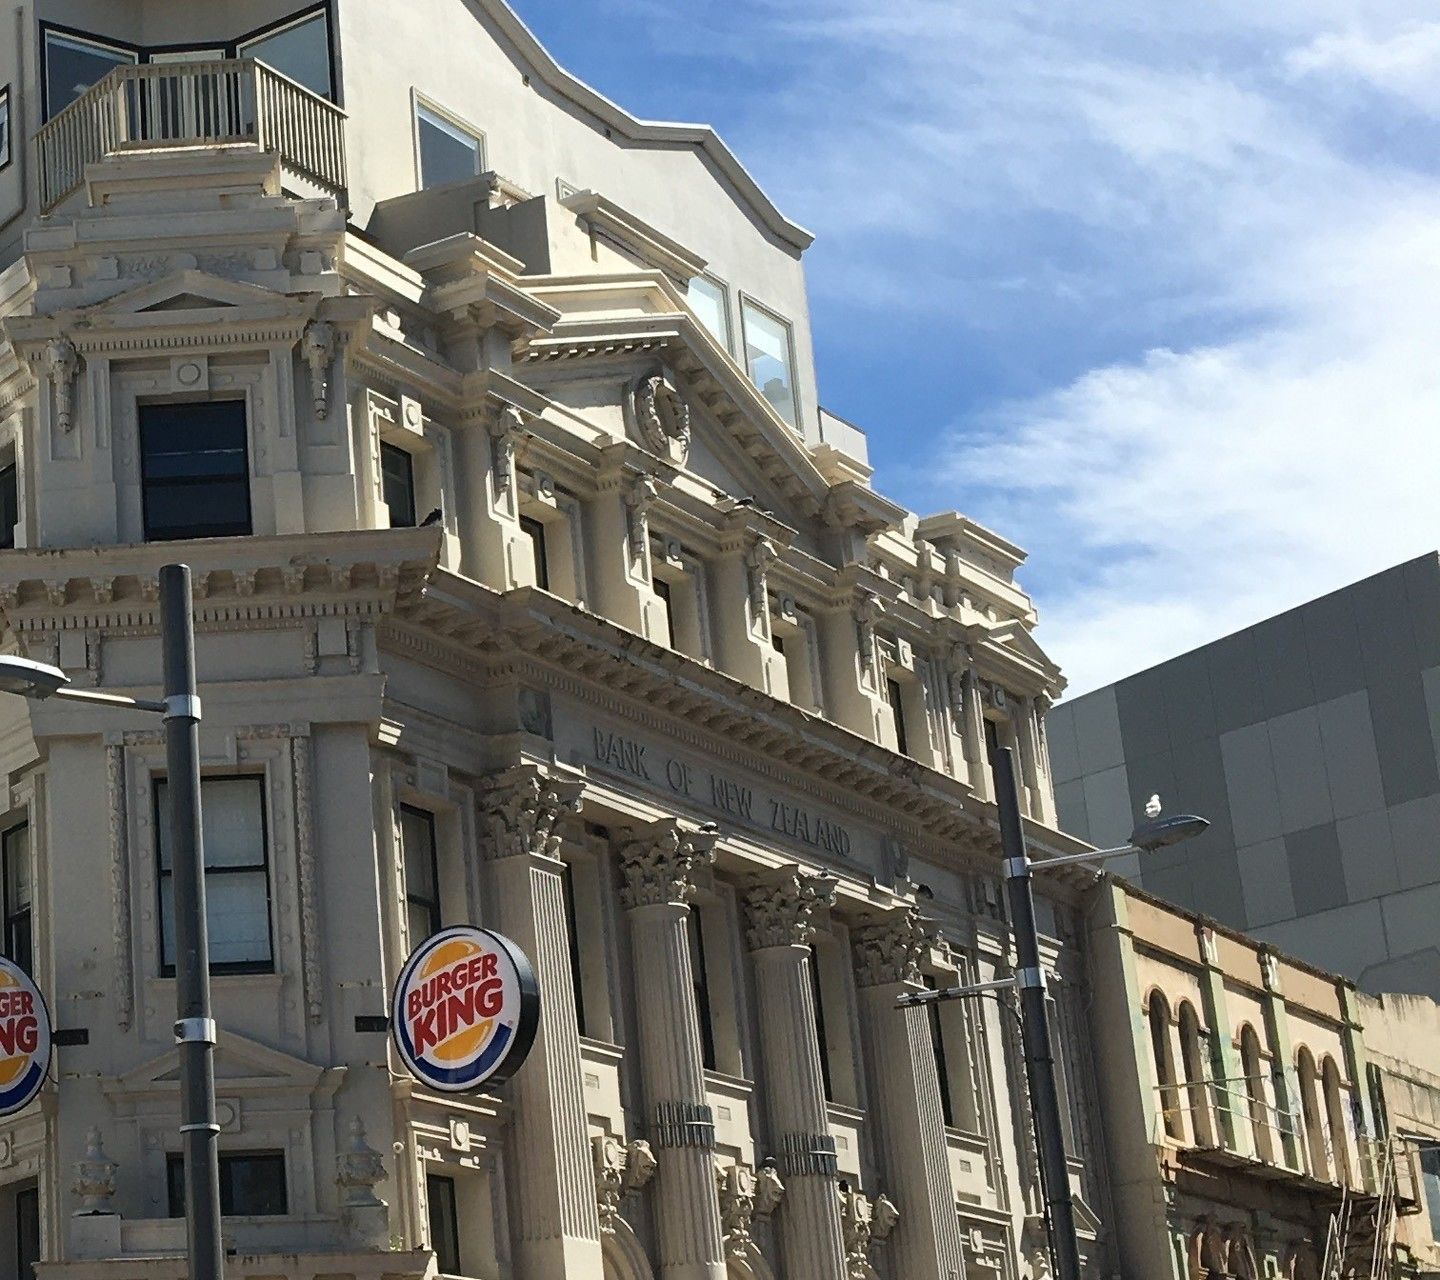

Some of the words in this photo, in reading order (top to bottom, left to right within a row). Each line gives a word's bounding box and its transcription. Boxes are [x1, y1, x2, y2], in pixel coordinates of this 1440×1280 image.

[593, 726, 650, 780] BANK
[666, 759, 692, 796] OF
[710, 774, 753, 819] NEW
[769, 797, 852, 857] ZEALAND
[406, 952, 498, 1022] BURGER
[412, 977, 504, 1059] KING
